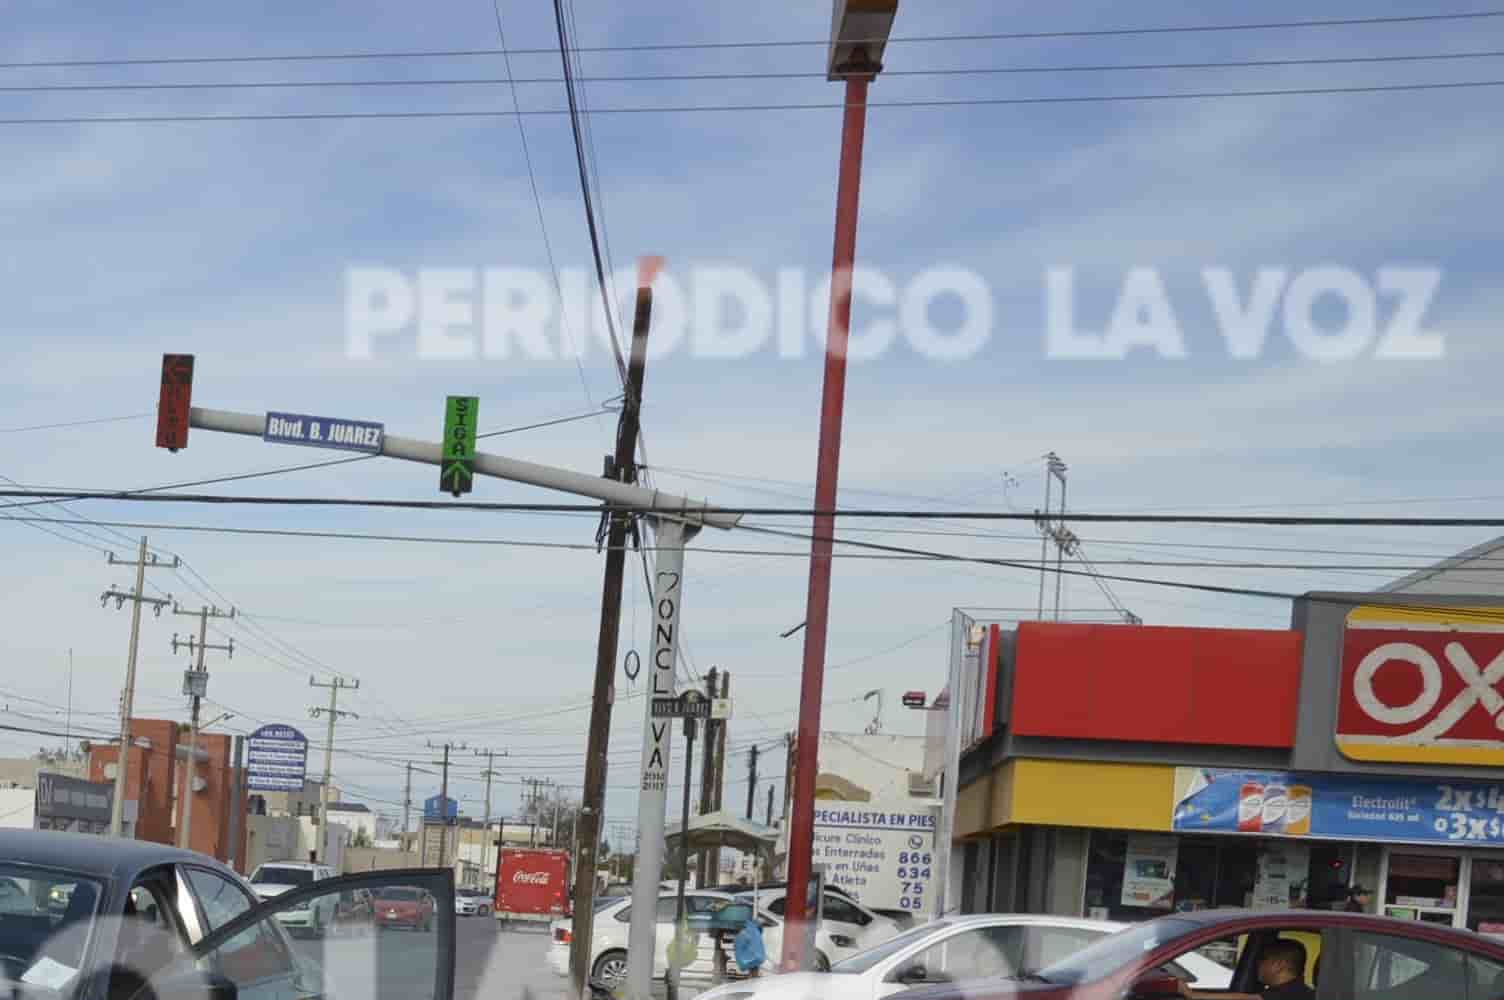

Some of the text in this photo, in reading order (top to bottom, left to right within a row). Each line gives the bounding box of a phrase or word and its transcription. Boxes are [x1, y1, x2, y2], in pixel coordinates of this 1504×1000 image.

[269, 418, 380, 447] Blvd. B. JUAREZ
[452, 399, 468, 456] SIGA
[890, 815, 905, 825] EN
[909, 815, 937, 828] PIES
[899, 851, 931, 865] 866
[897, 867, 930, 879] 634
[901, 882, 923, 894] 75
[900, 896, 921, 909] 05
